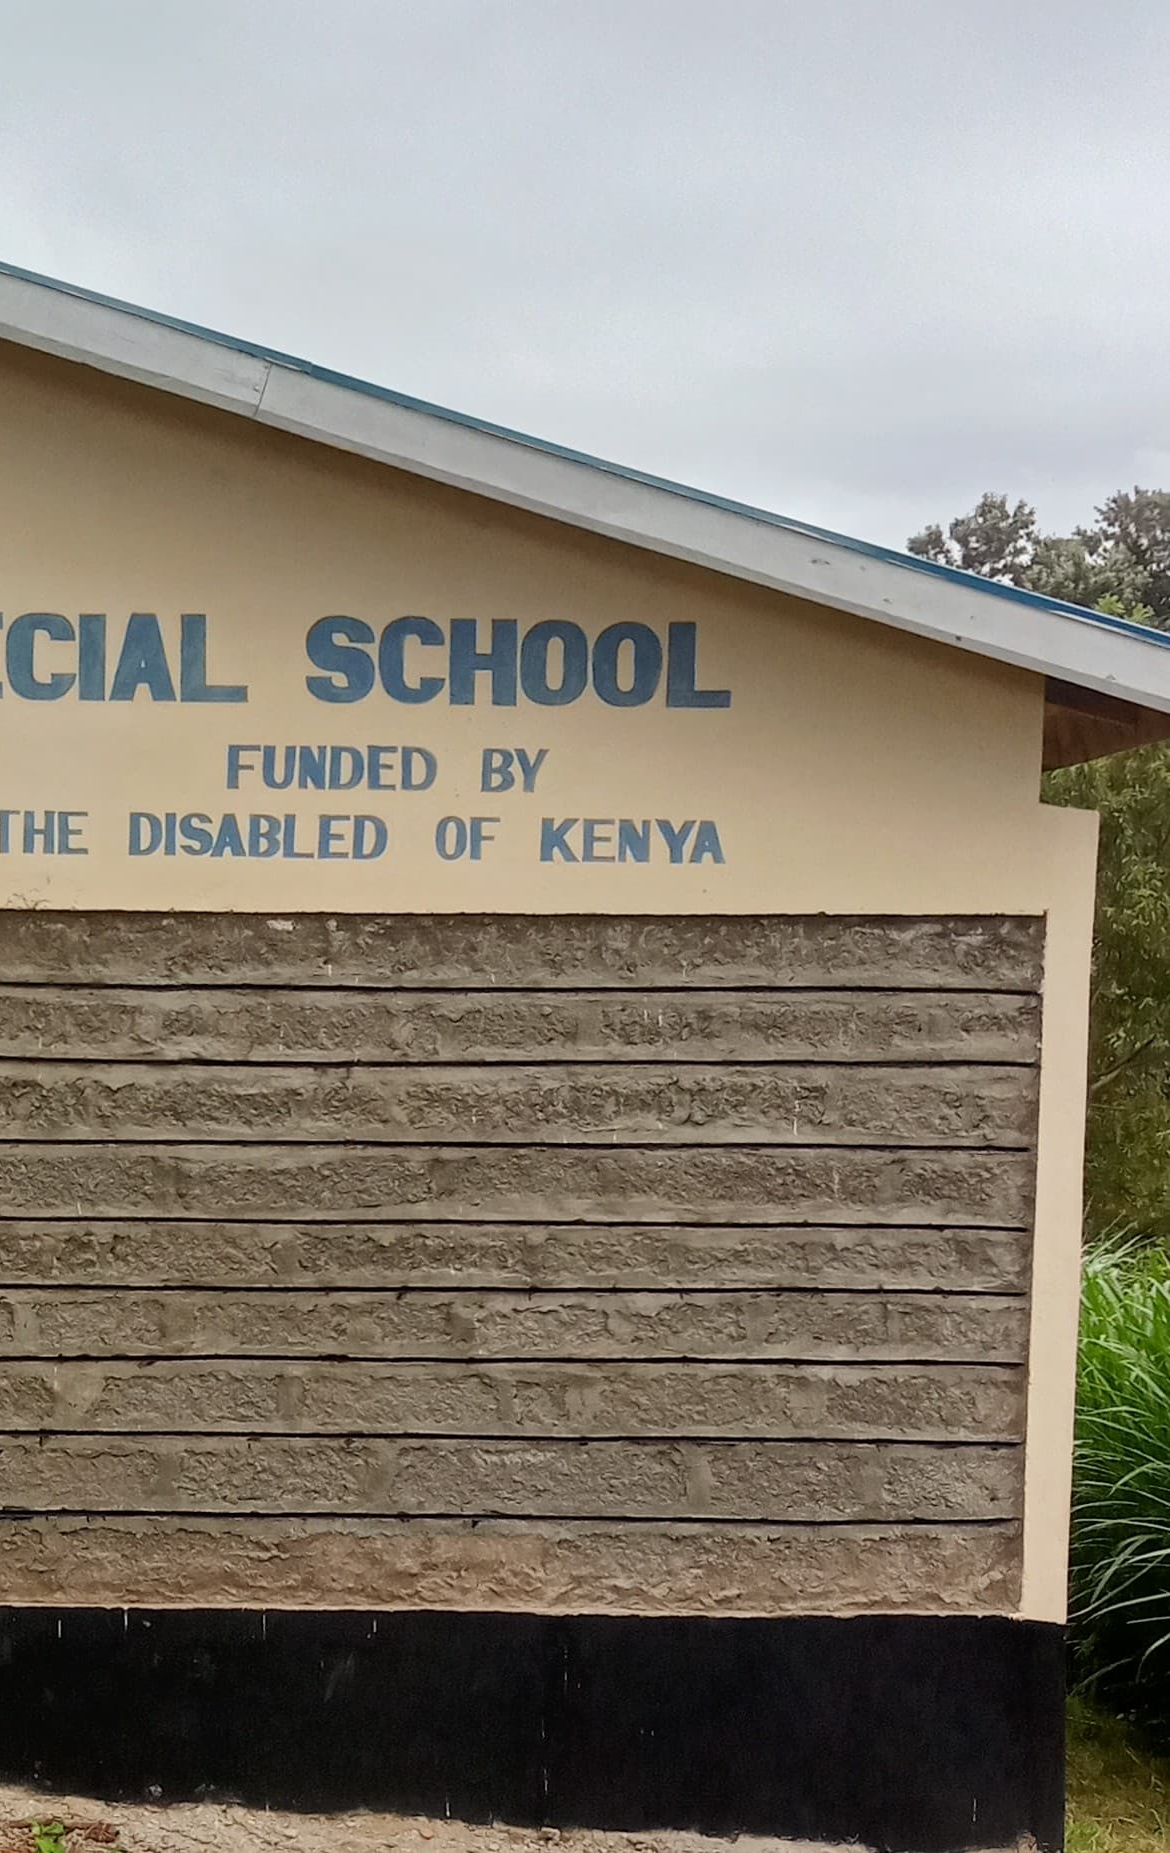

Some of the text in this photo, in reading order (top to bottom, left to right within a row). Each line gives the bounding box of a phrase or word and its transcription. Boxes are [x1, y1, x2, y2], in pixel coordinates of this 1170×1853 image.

[305, 615, 732, 710] SCHOOL
[226, 744, 438, 792] FUNDED
[482, 748, 550, 793] BY
[129, 811, 389, 861] DISABLED
[435, 816, 501, 862] OF
[540, 818, 726, 866] KENYA
